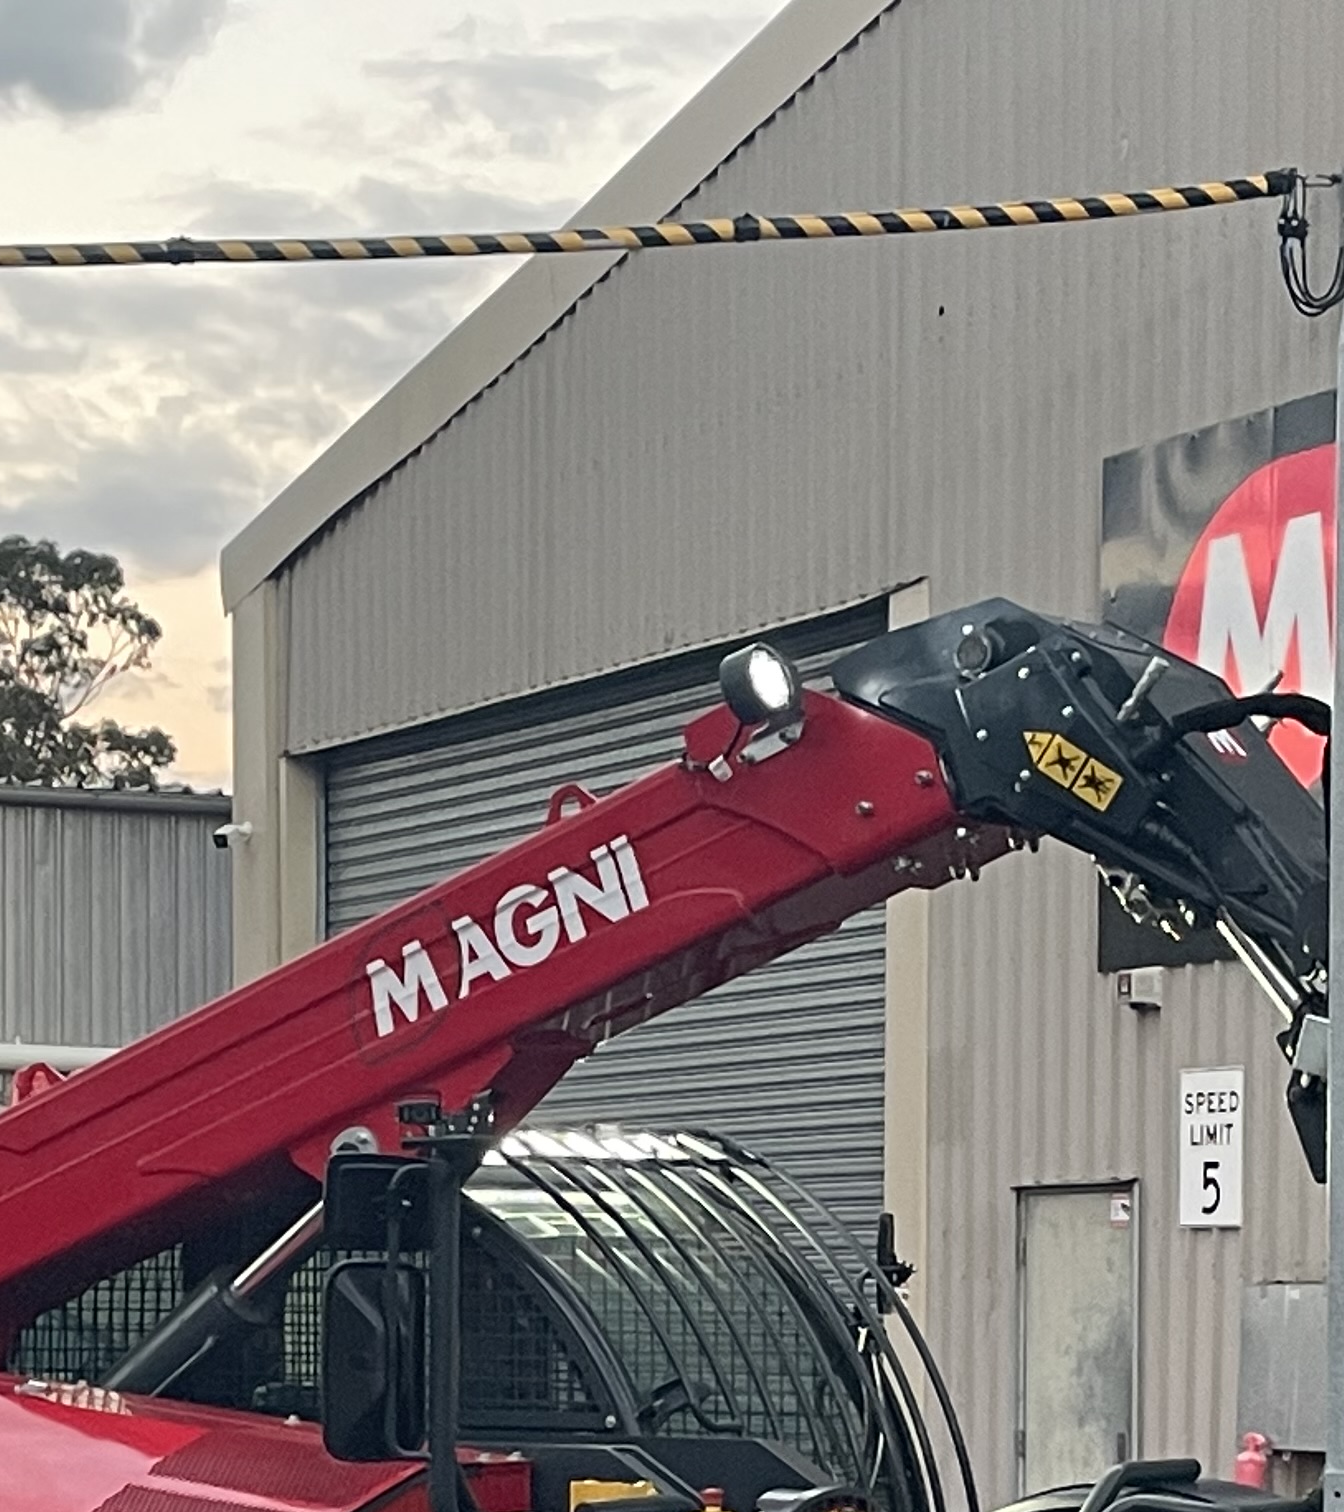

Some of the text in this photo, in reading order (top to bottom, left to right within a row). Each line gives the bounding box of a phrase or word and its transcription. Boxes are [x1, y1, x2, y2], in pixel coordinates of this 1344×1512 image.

[366, 834, 649, 1038] MAGNI
[1184, 1090, 1239, 1115] SPEED
[1190, 1123, 1233, 1146] LIMIT
[1201, 1161, 1221, 1215] 5
